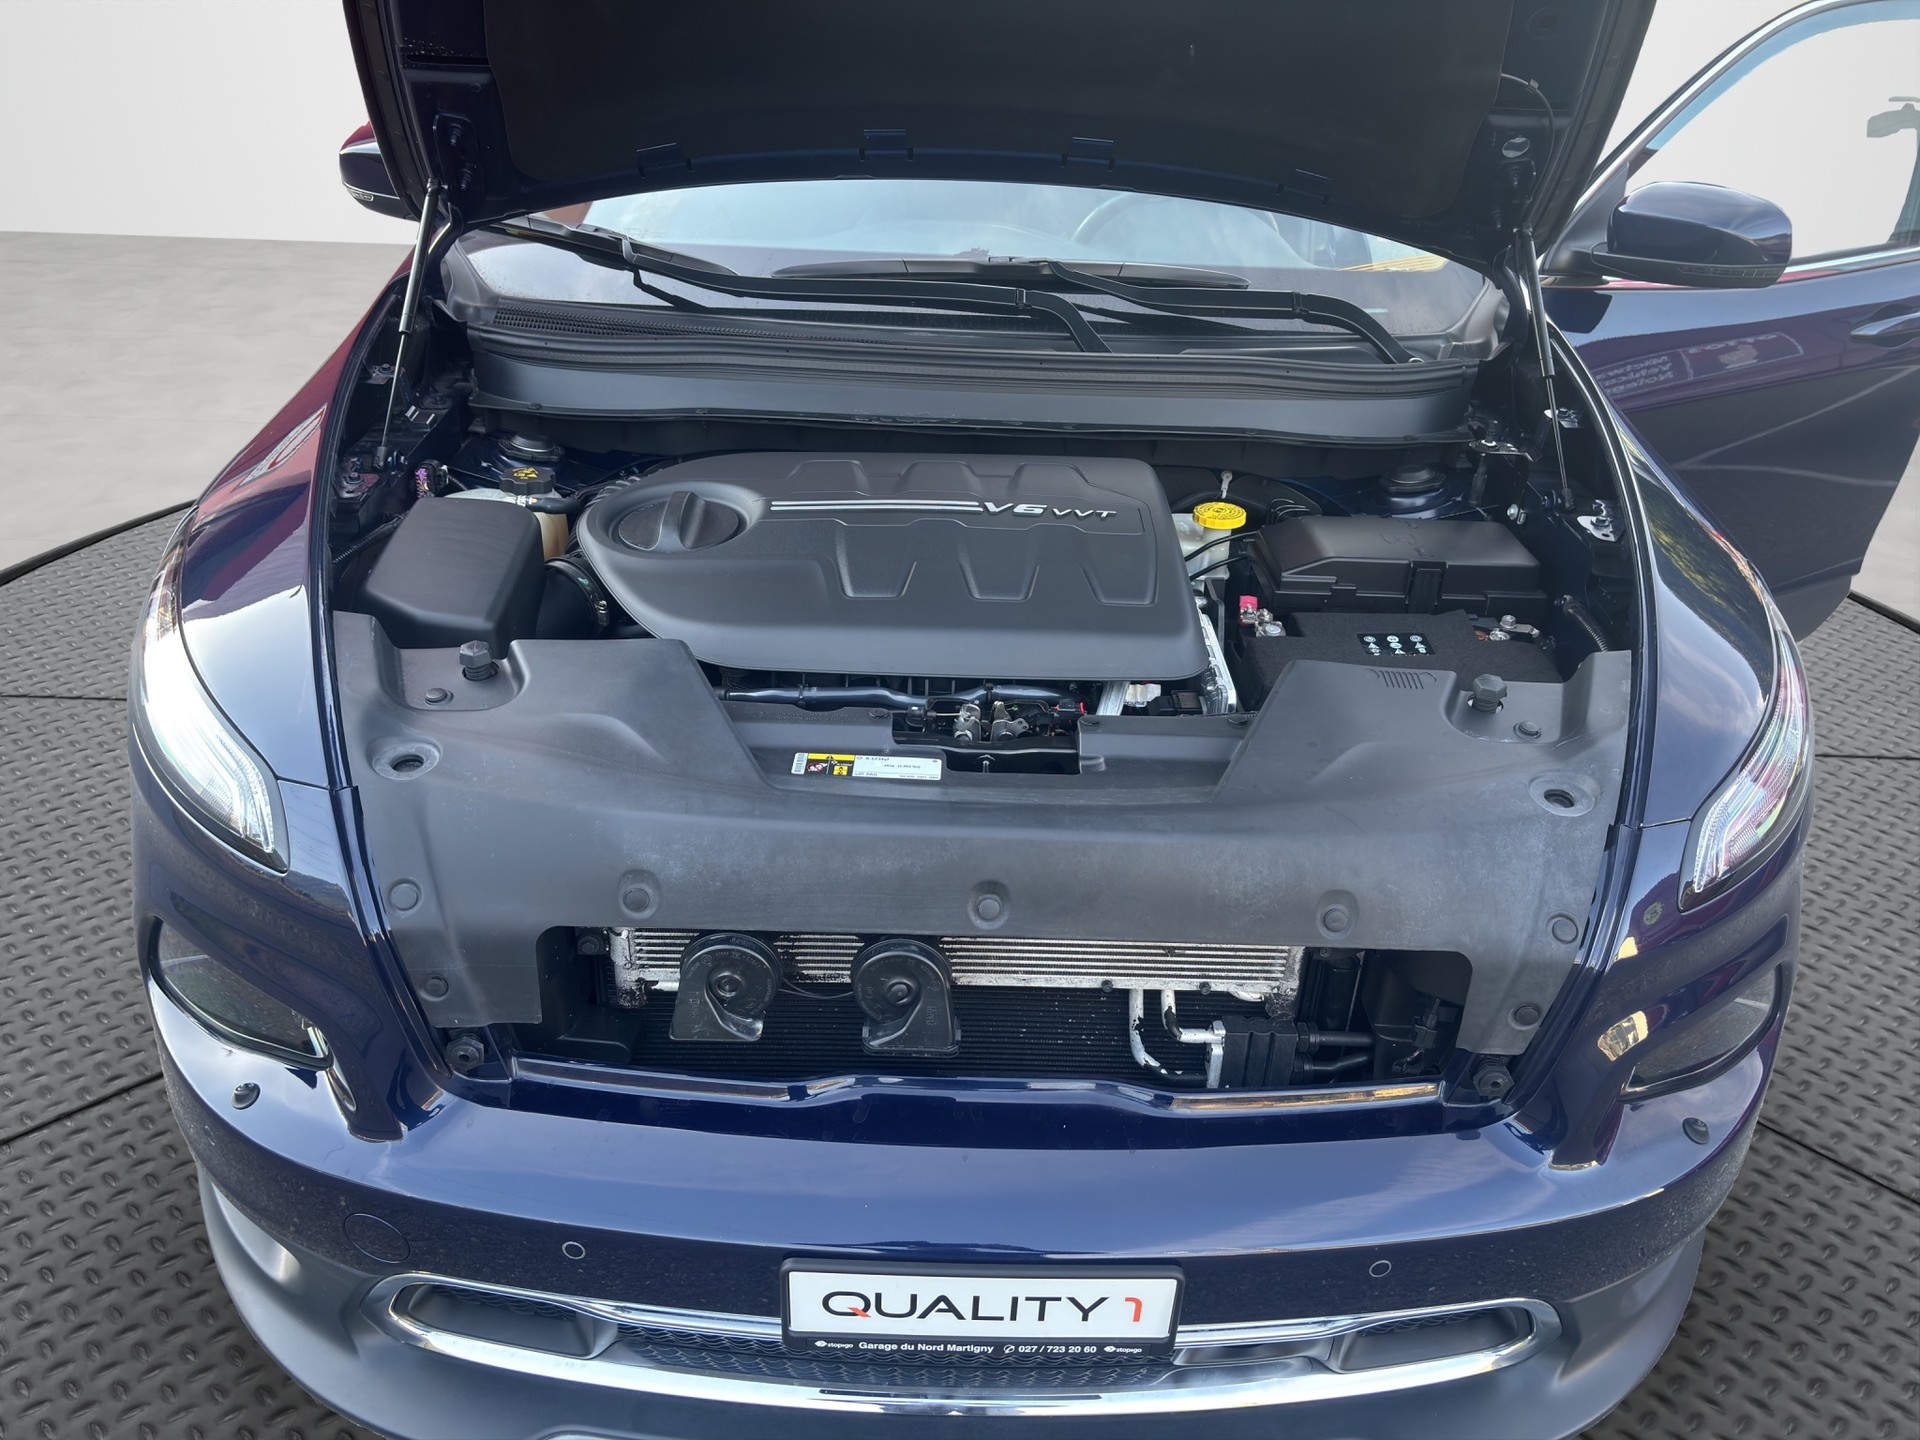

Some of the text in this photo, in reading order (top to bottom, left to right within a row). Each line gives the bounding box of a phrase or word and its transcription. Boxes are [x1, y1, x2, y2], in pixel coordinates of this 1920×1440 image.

[984, 502, 1117, 519] V6 VVT
[822, 1290, 1142, 1322] QUALITY 1
[858, 1341, 994, 1354] Garage du Nord Martigny
[1018, 1345, 1038, 1353] 027
[1039, 1345, 1045, 1353] /
[1046, 1345, 1066, 1353] 723
